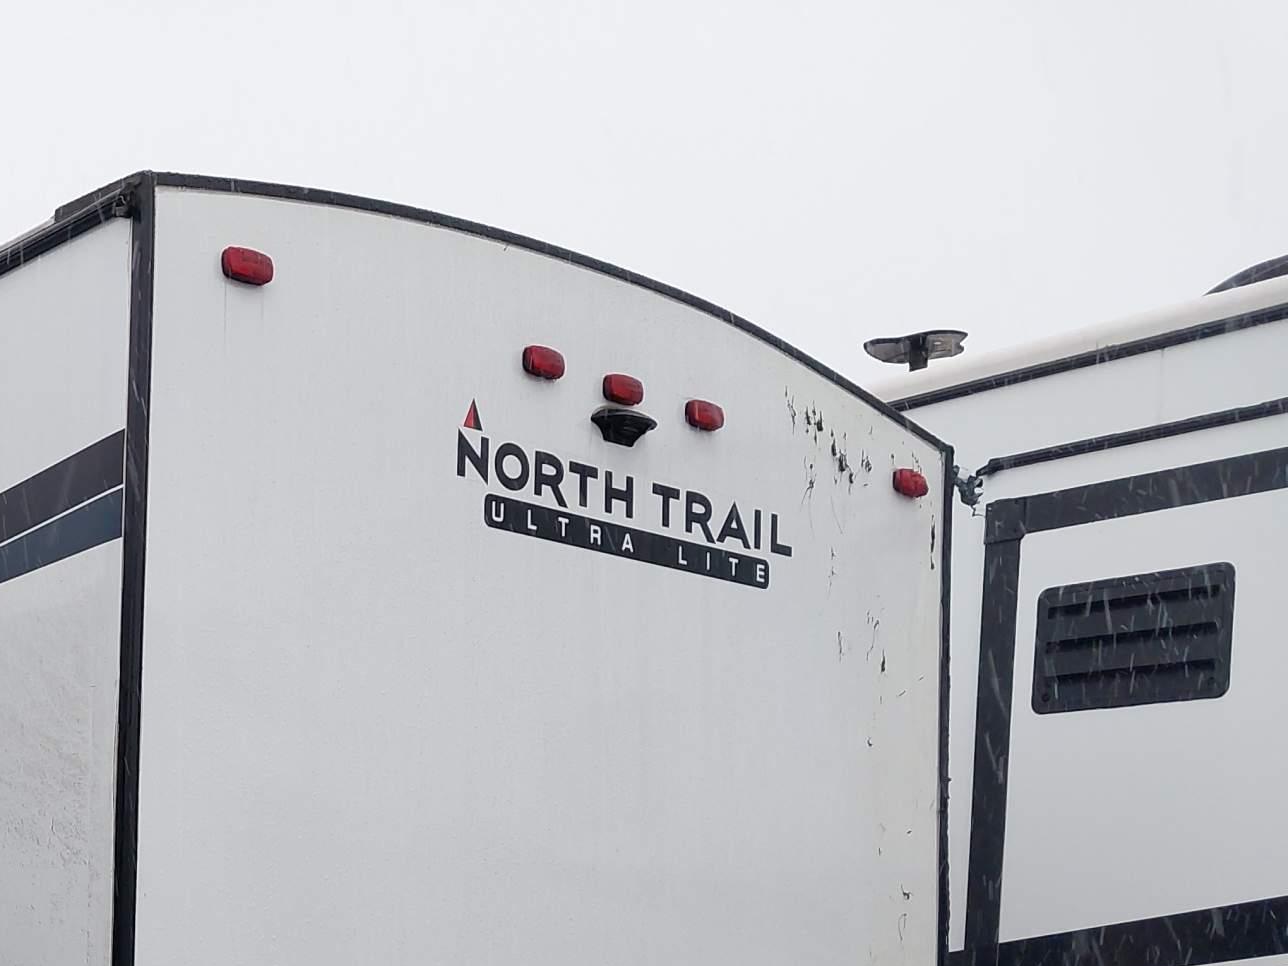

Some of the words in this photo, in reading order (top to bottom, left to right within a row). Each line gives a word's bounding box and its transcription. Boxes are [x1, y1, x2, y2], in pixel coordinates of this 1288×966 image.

[457, 428, 634, 518] NORTH
[652, 482, 793, 557] TRAIL
[491, 501, 634, 552] ULTRA
[679, 545, 766, 583] LITE
